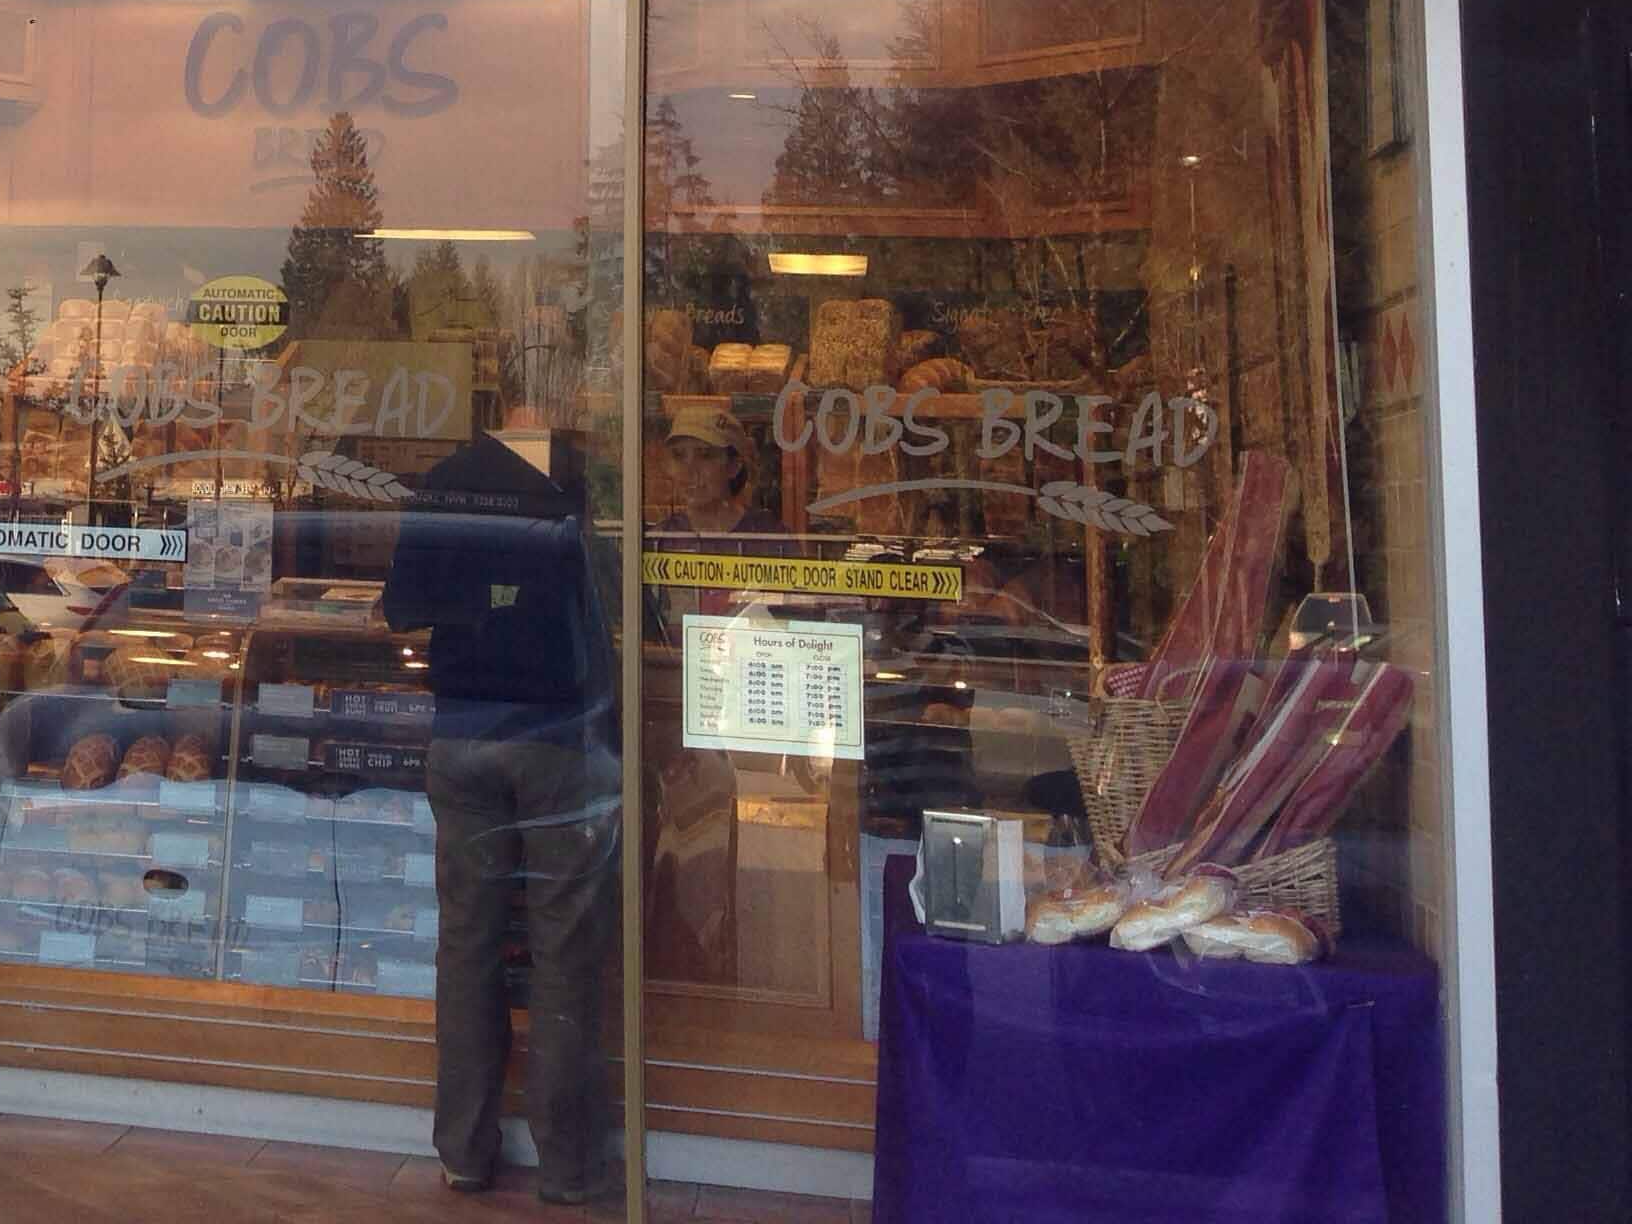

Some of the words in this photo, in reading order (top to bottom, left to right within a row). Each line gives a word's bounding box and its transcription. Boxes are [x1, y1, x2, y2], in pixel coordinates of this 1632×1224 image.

[184, 11, 459, 119] COBS
[203, 288, 274, 299] AUTOMATIC
[199, 303, 280, 322] CAUTION
[220, 327, 257, 337] DOOR
[64, 359, 224, 428] COBS
[250, 363, 458, 439] BREAD
[773, 378, 950, 457] COBS
[975, 385, 1218, 469] BREAD
[81, 532, 141, 552] DOOR
[674, 559, 723, 581] CAUTION
[732, 564, 797, 586] AUTOMATIC
[803, 567, 837, 588] DOOR
[846, 569, 884, 590] STAND
[889, 571, 929, 592] CLEAR
[753, 636, 783, 648] Hours
[784, 637, 796, 648] of
[798, 639, 833, 652] Delight
